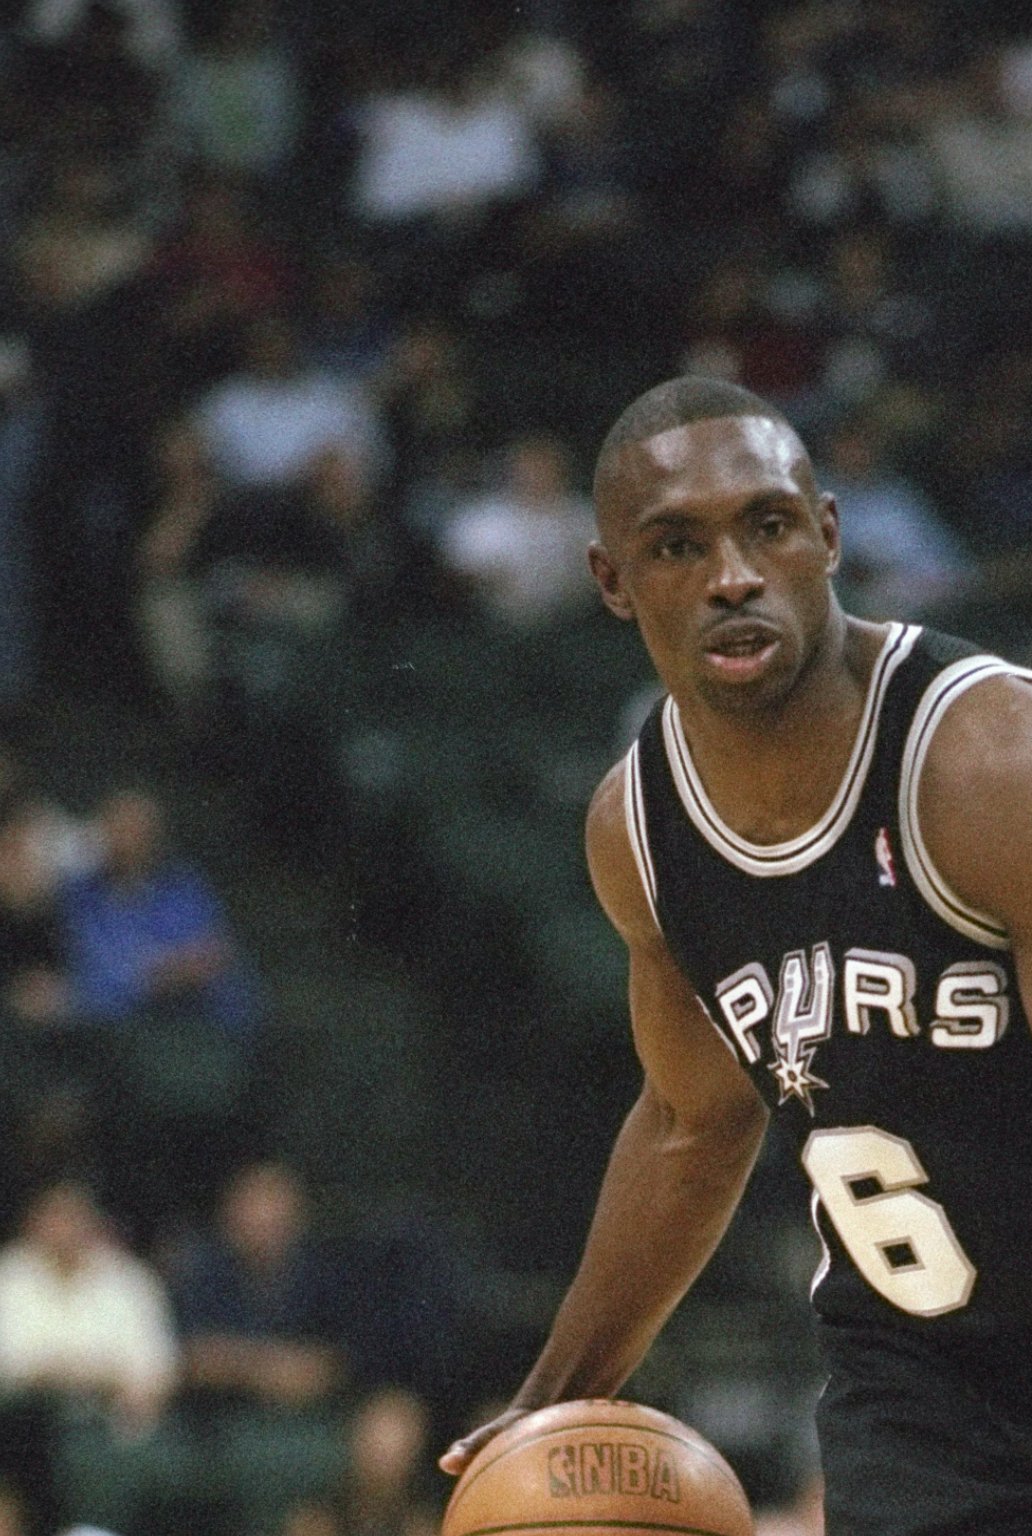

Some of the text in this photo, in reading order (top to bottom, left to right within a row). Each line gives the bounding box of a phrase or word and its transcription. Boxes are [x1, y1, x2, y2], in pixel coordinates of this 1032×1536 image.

[696, 941, 1009, 1117] PURS
[801, 1125, 977, 1318] 6
[579, 1442, 681, 1504] NBA
